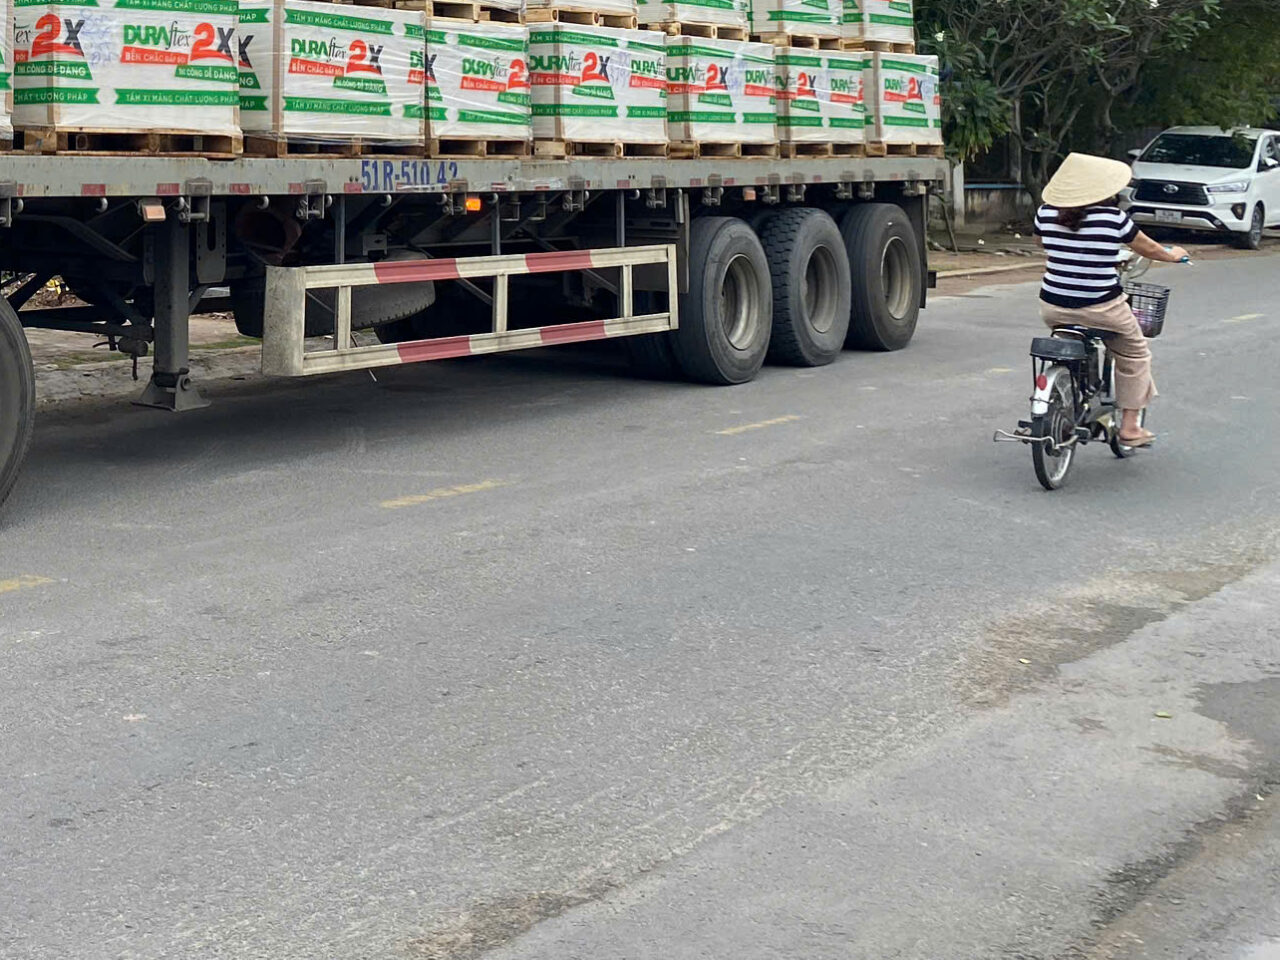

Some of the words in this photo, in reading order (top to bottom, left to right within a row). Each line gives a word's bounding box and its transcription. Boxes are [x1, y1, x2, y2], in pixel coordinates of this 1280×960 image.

[31, 13, 85, 57] 2X
[123, 21, 191, 50] DURAflex
[191, 22, 235, 62] 2X
[346, 40, 384, 75] 2X
[582, 52, 610, 83] 2X
[706, 63, 728, 90] 2X
